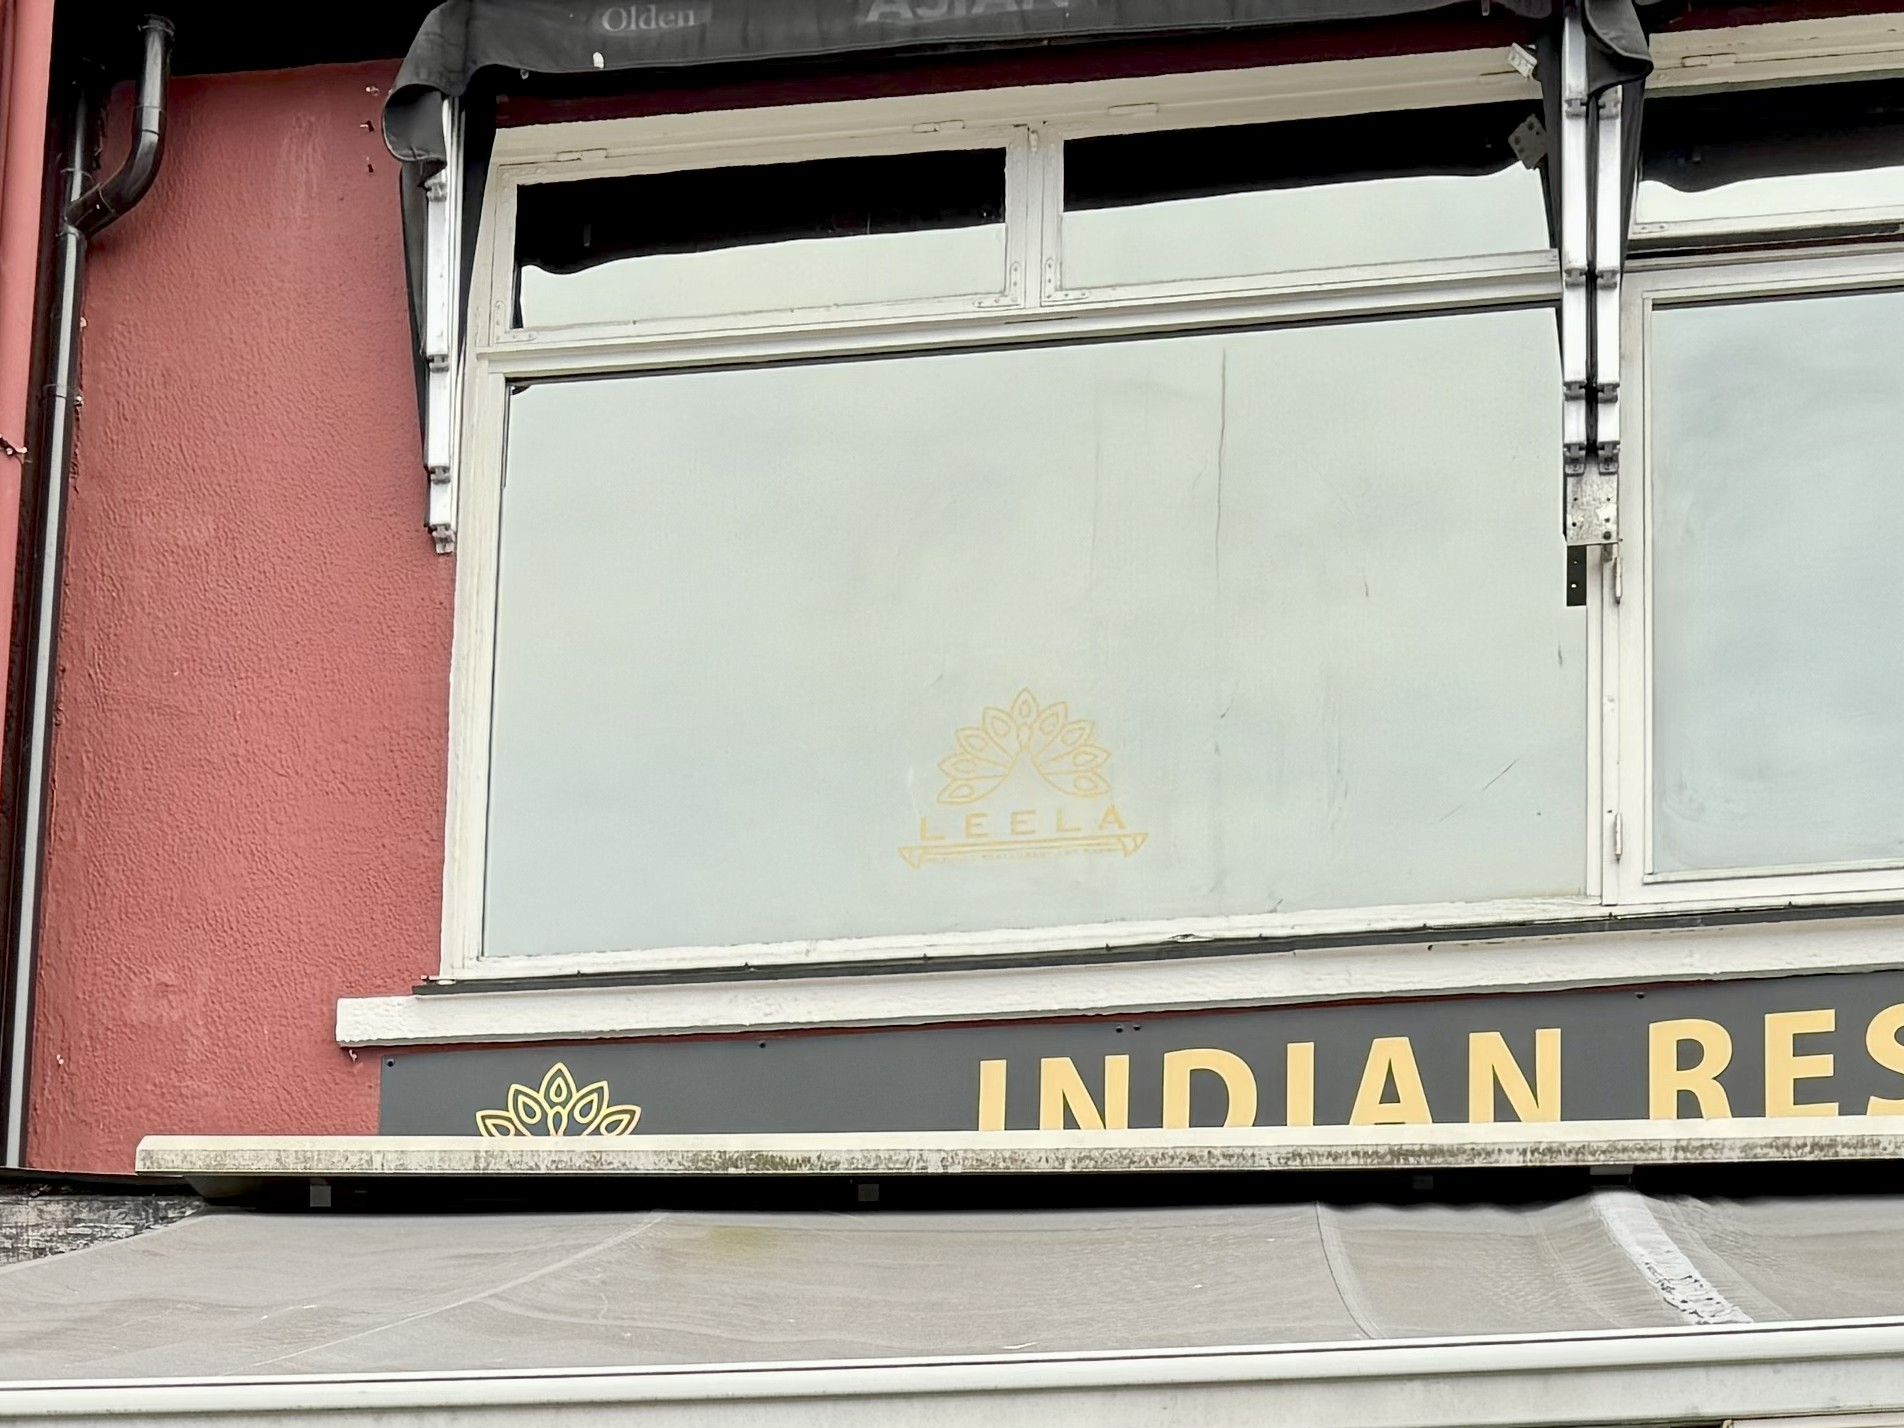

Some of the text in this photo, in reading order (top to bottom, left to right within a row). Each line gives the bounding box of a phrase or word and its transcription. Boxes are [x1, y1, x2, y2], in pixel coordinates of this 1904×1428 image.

[601, 4, 696, 32] Olden
[918, 803, 1128, 842] LEELA
[978, 1027, 1562, 1131] INDIAN
